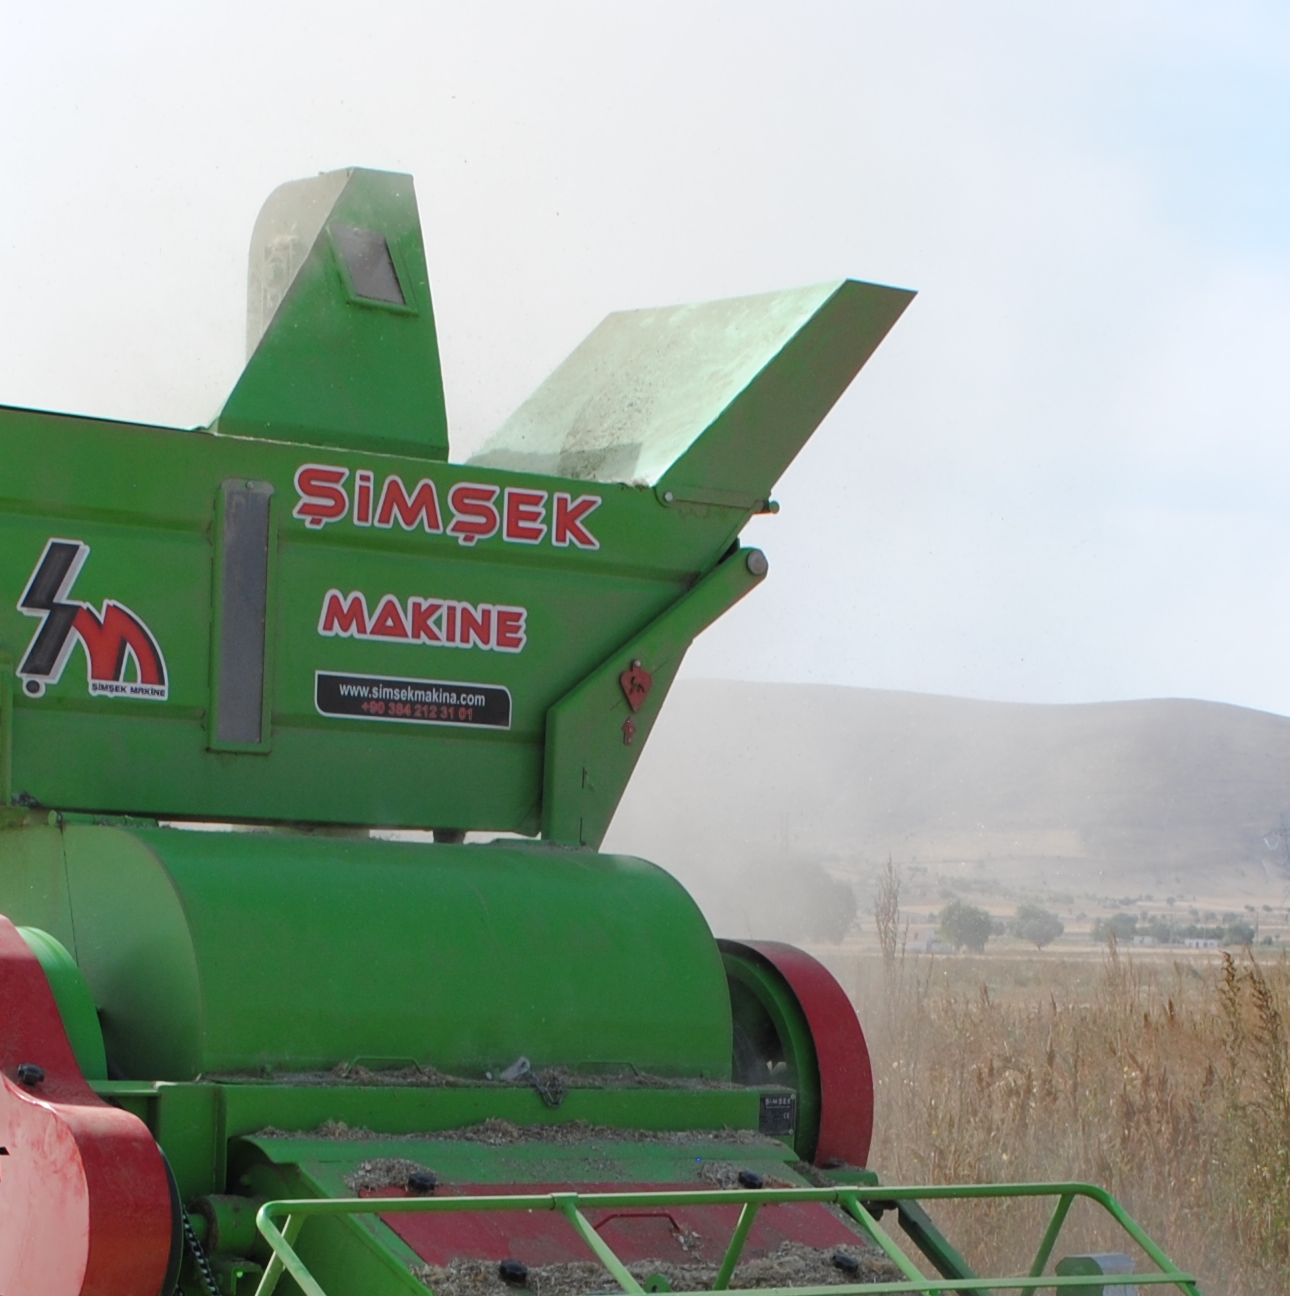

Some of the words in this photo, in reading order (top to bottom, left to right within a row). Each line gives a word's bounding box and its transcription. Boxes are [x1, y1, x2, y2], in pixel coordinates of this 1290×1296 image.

[339, 684, 486, 707] www.simsekmakina.com
[362, 700, 385, 714] +90
[414, 705, 437, 718] 212
[440, 706, 455, 720] 31
